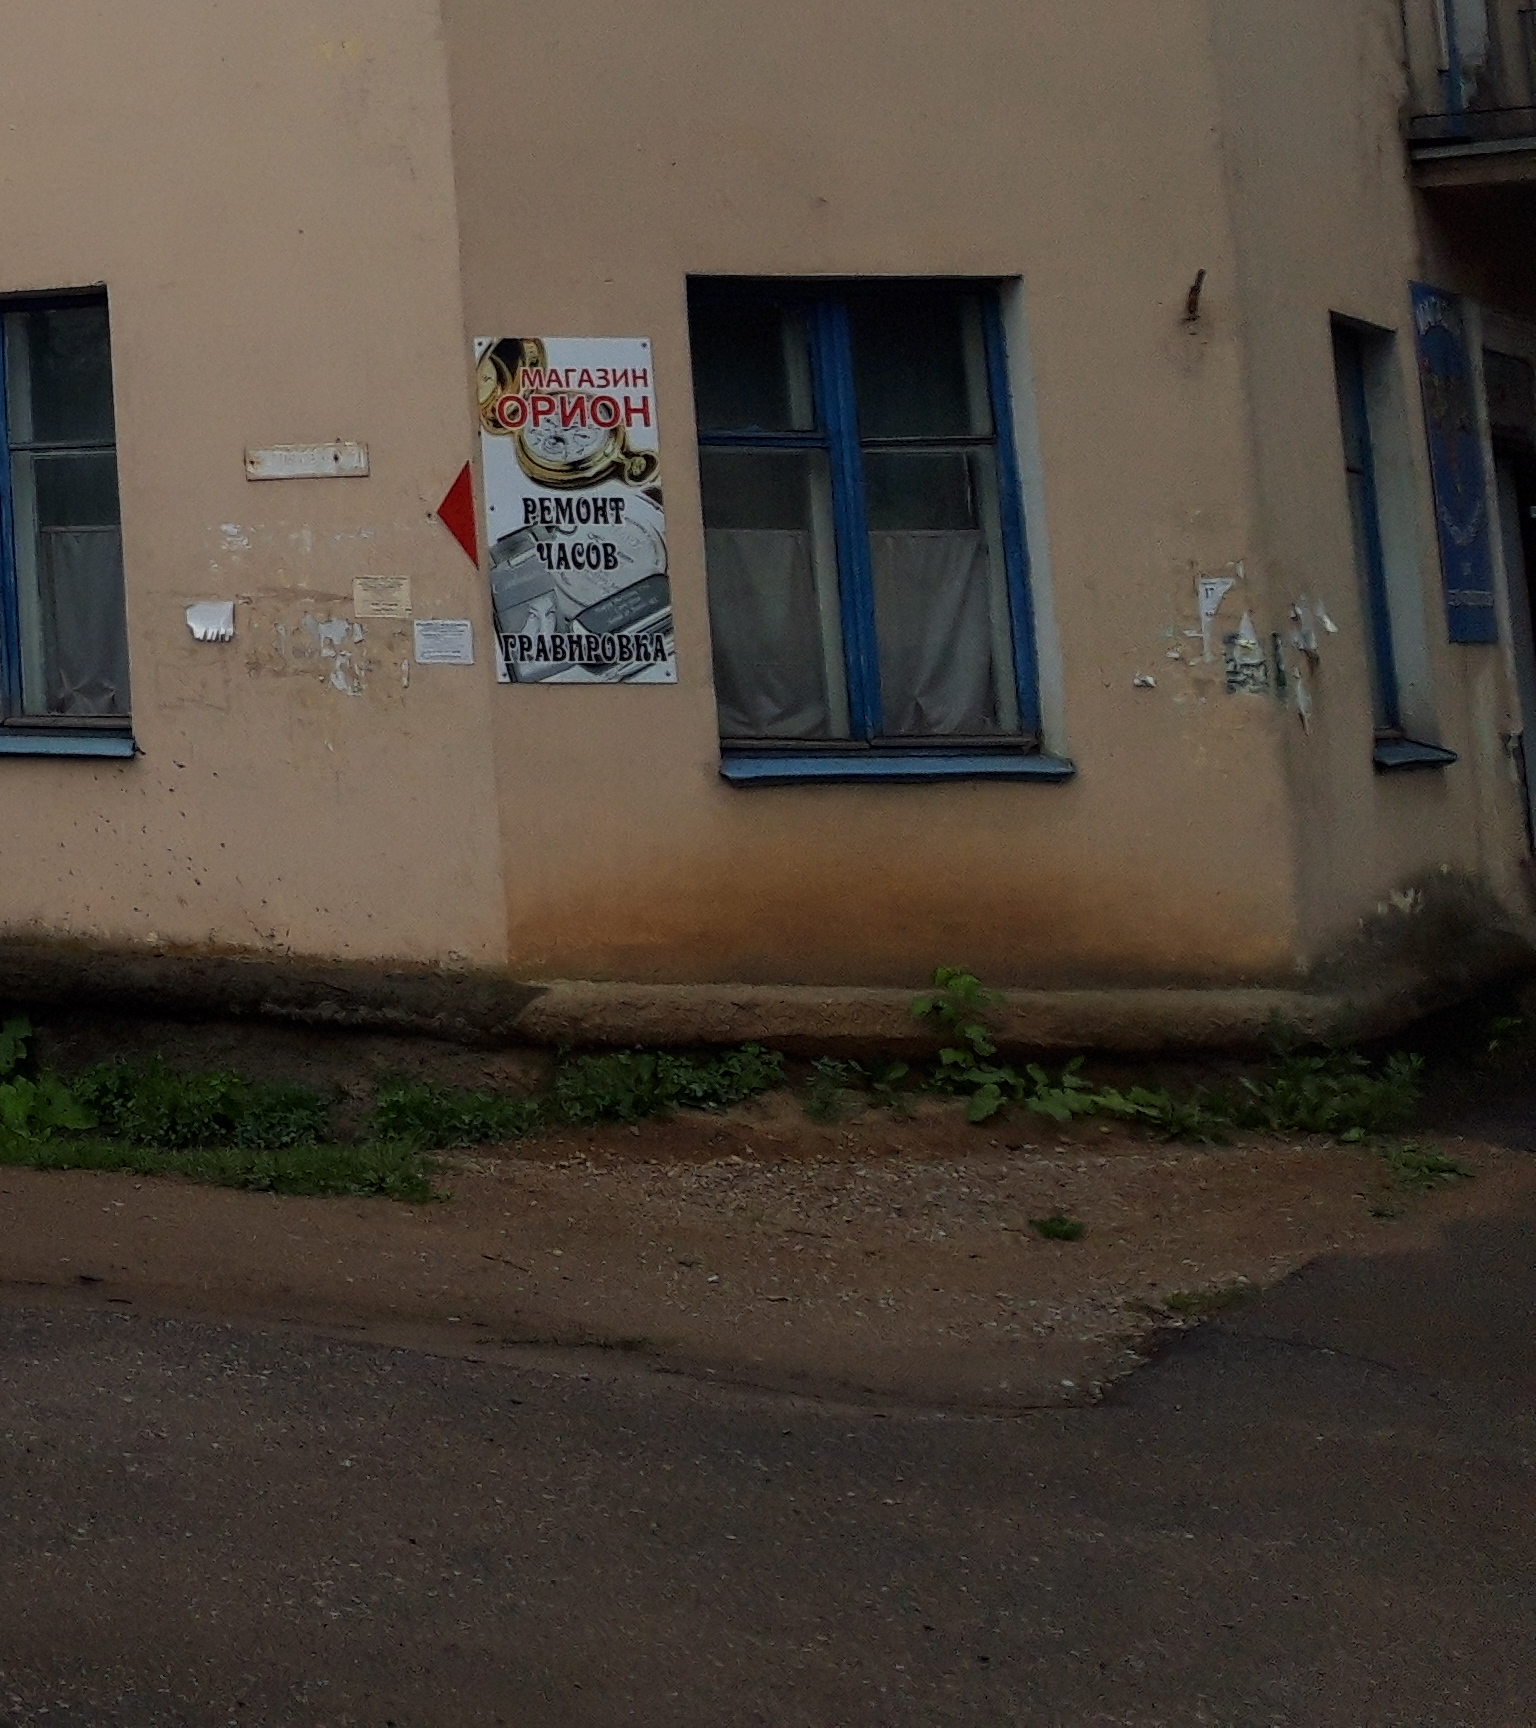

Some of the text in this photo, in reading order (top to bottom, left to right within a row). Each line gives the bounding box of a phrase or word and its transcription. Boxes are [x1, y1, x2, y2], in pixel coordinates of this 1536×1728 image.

[521, 368, 648, 388] МАГАЗИН
[497, 395, 650, 428] ОРИОН
[522, 497, 625, 524] РЕМОНТ
[537, 543, 618, 570] ЧАСОВ
[502, 634, 667, 662] ГРАВИРОВКА
